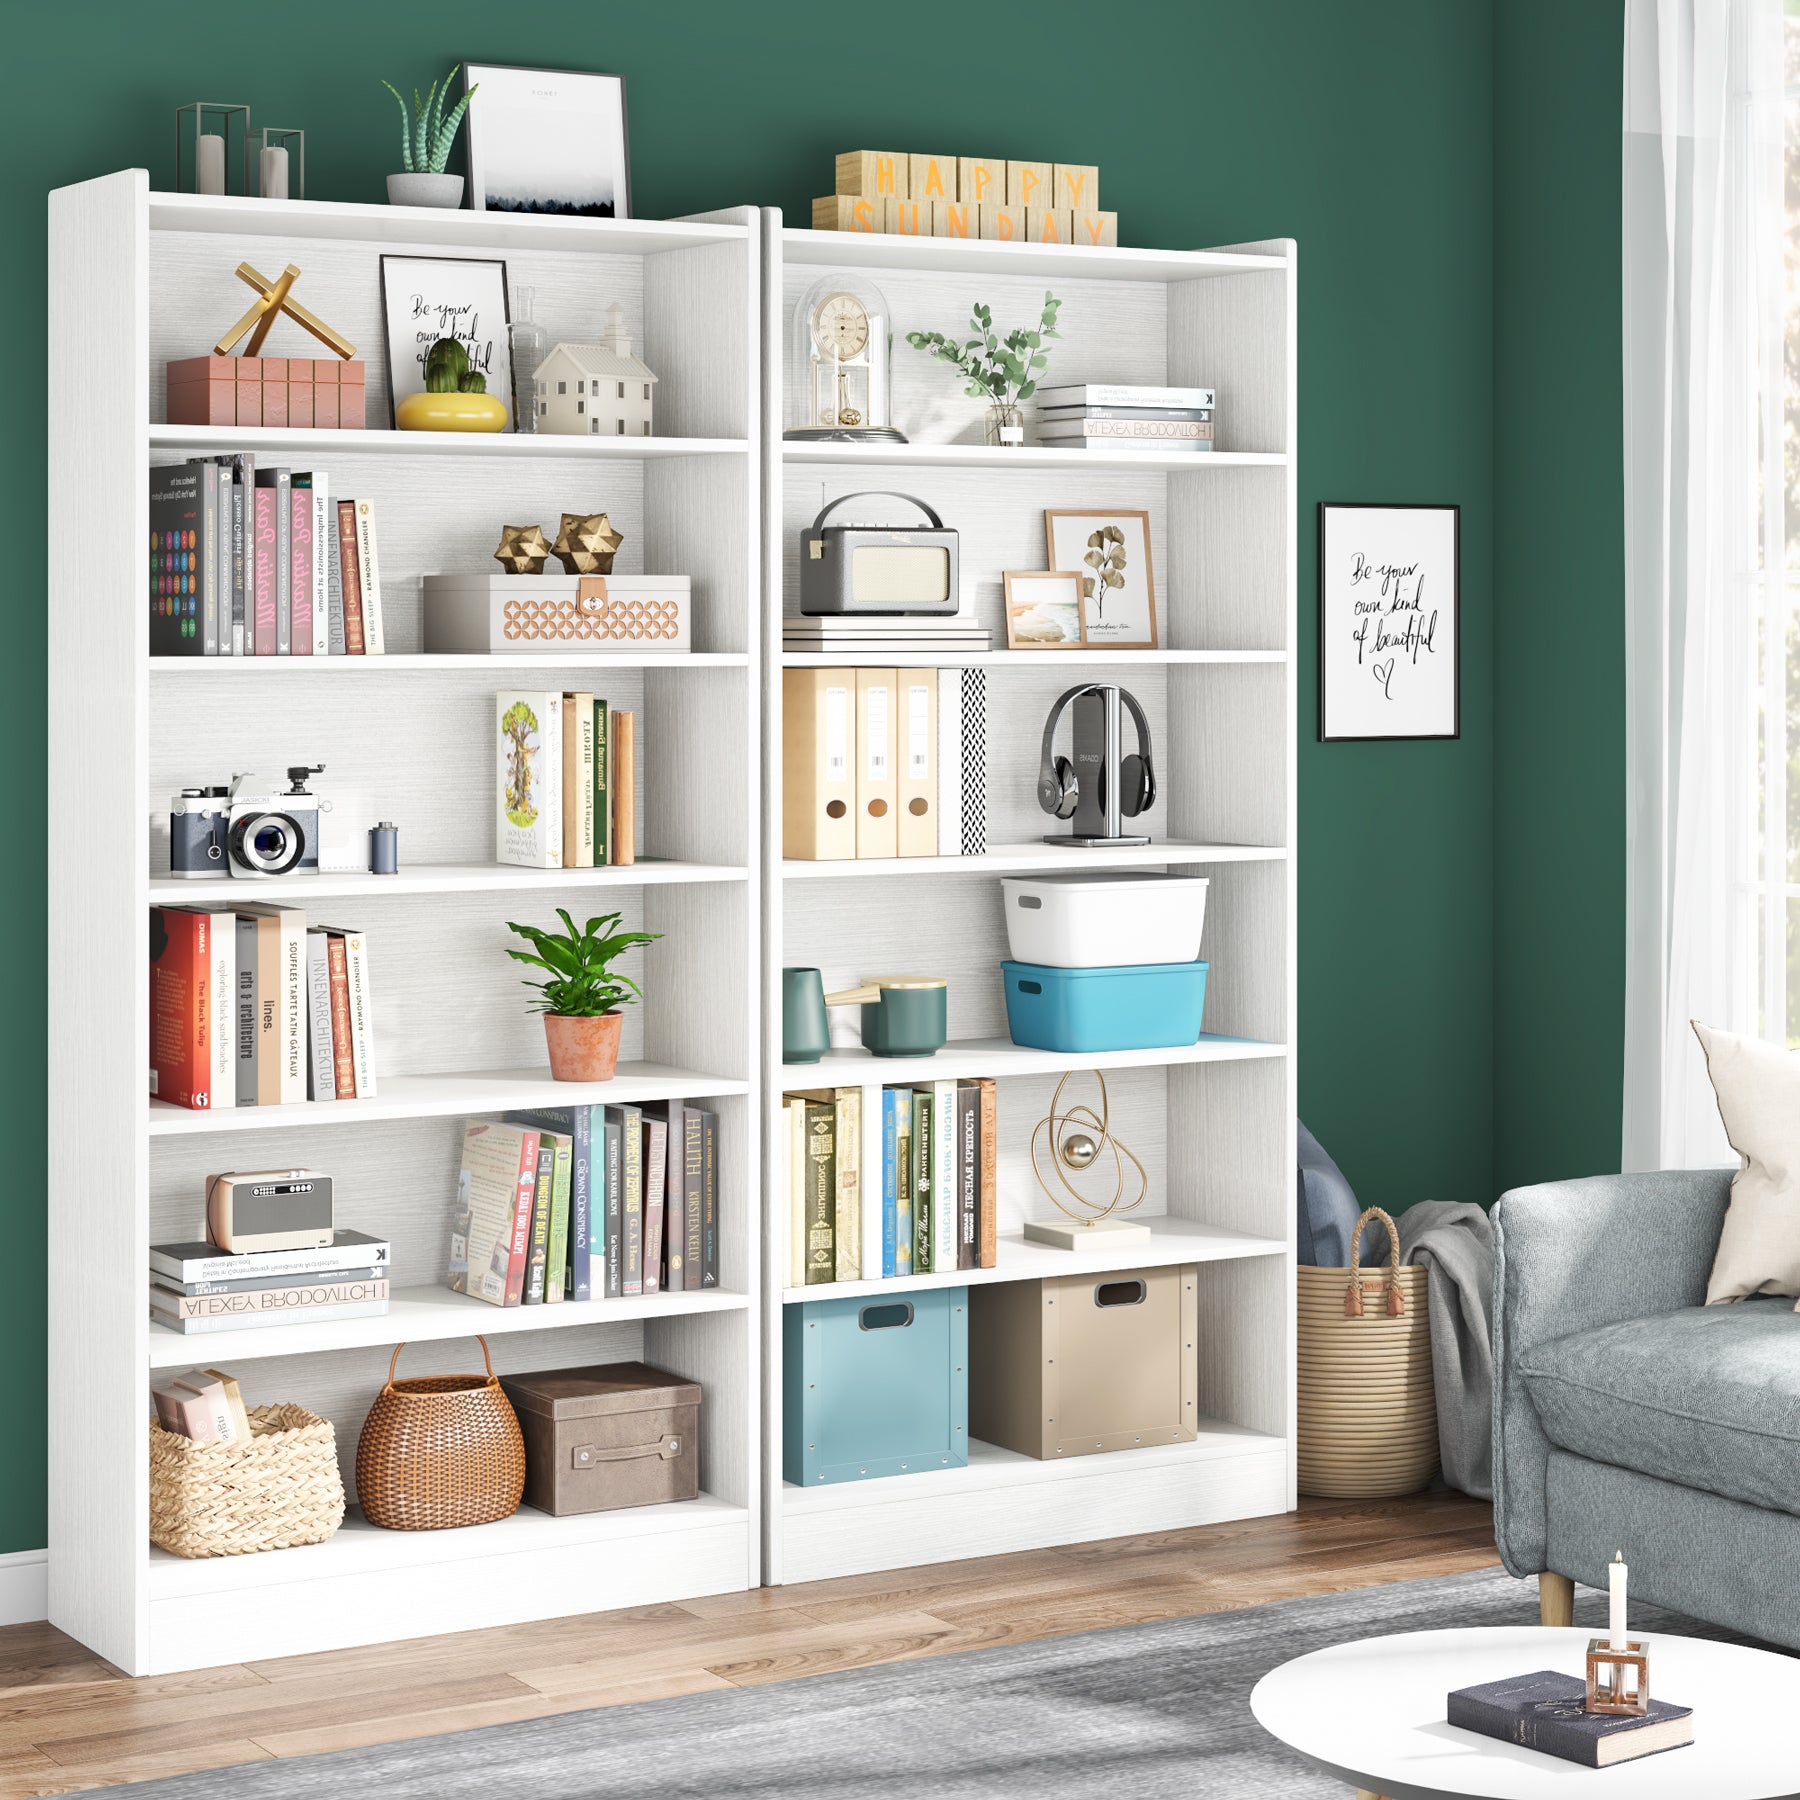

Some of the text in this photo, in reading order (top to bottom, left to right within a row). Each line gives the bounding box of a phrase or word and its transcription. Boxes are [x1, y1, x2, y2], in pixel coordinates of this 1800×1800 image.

[877, 158, 1085, 207] HAPPY
[849, 200, 1104, 246] SUNDAY
[411, 295, 472, 328] Be your
[328, 520, 342, 645] INNENARCHITEKTUR
[364, 557, 372, 590] RAYMOND
[1350, 552, 1419, 596] Be your
[1354, 574, 1424, 616] own kind
[1353, 610, 1438, 664] of beautiful
[240, 971, 253, 989] arts
[218, 960, 228, 1074] exploring black sand beaches
[240, 1004, 253, 1059] architecture
[264, 1000, 274, 1032] lines.
[313, 958, 333, 1090] INNENARCHITEKTUR
[944, 1093, 952, 1140] ПОЭМЫ
[626, 1112, 640, 1213] THE PROPHECY OF ZEPHYRUS
[650, 1132, 665, 1207] GEOSYNCHRON
[965, 1110, 974, 1209] ЛЕСНАЯ КРЕПОСТЬ
[537, 1176, 549, 1210] DUNGEON
[577, 1159, 586, 1249] CROWN CONSPIRACY
[686, 1118, 702, 1262] HALITH KIRSTEN KELLY
[513, 1192, 530, 1254] KEDAI 1001 MIMPI
[534, 1223, 545, 1244] DEATH
[536, 1212, 546, 1222] OF
[629, 1218, 637, 1228] G.
[629, 1232, 637, 1242] A.
[943, 1187, 951, 1255] АЛЕКСАНДР
